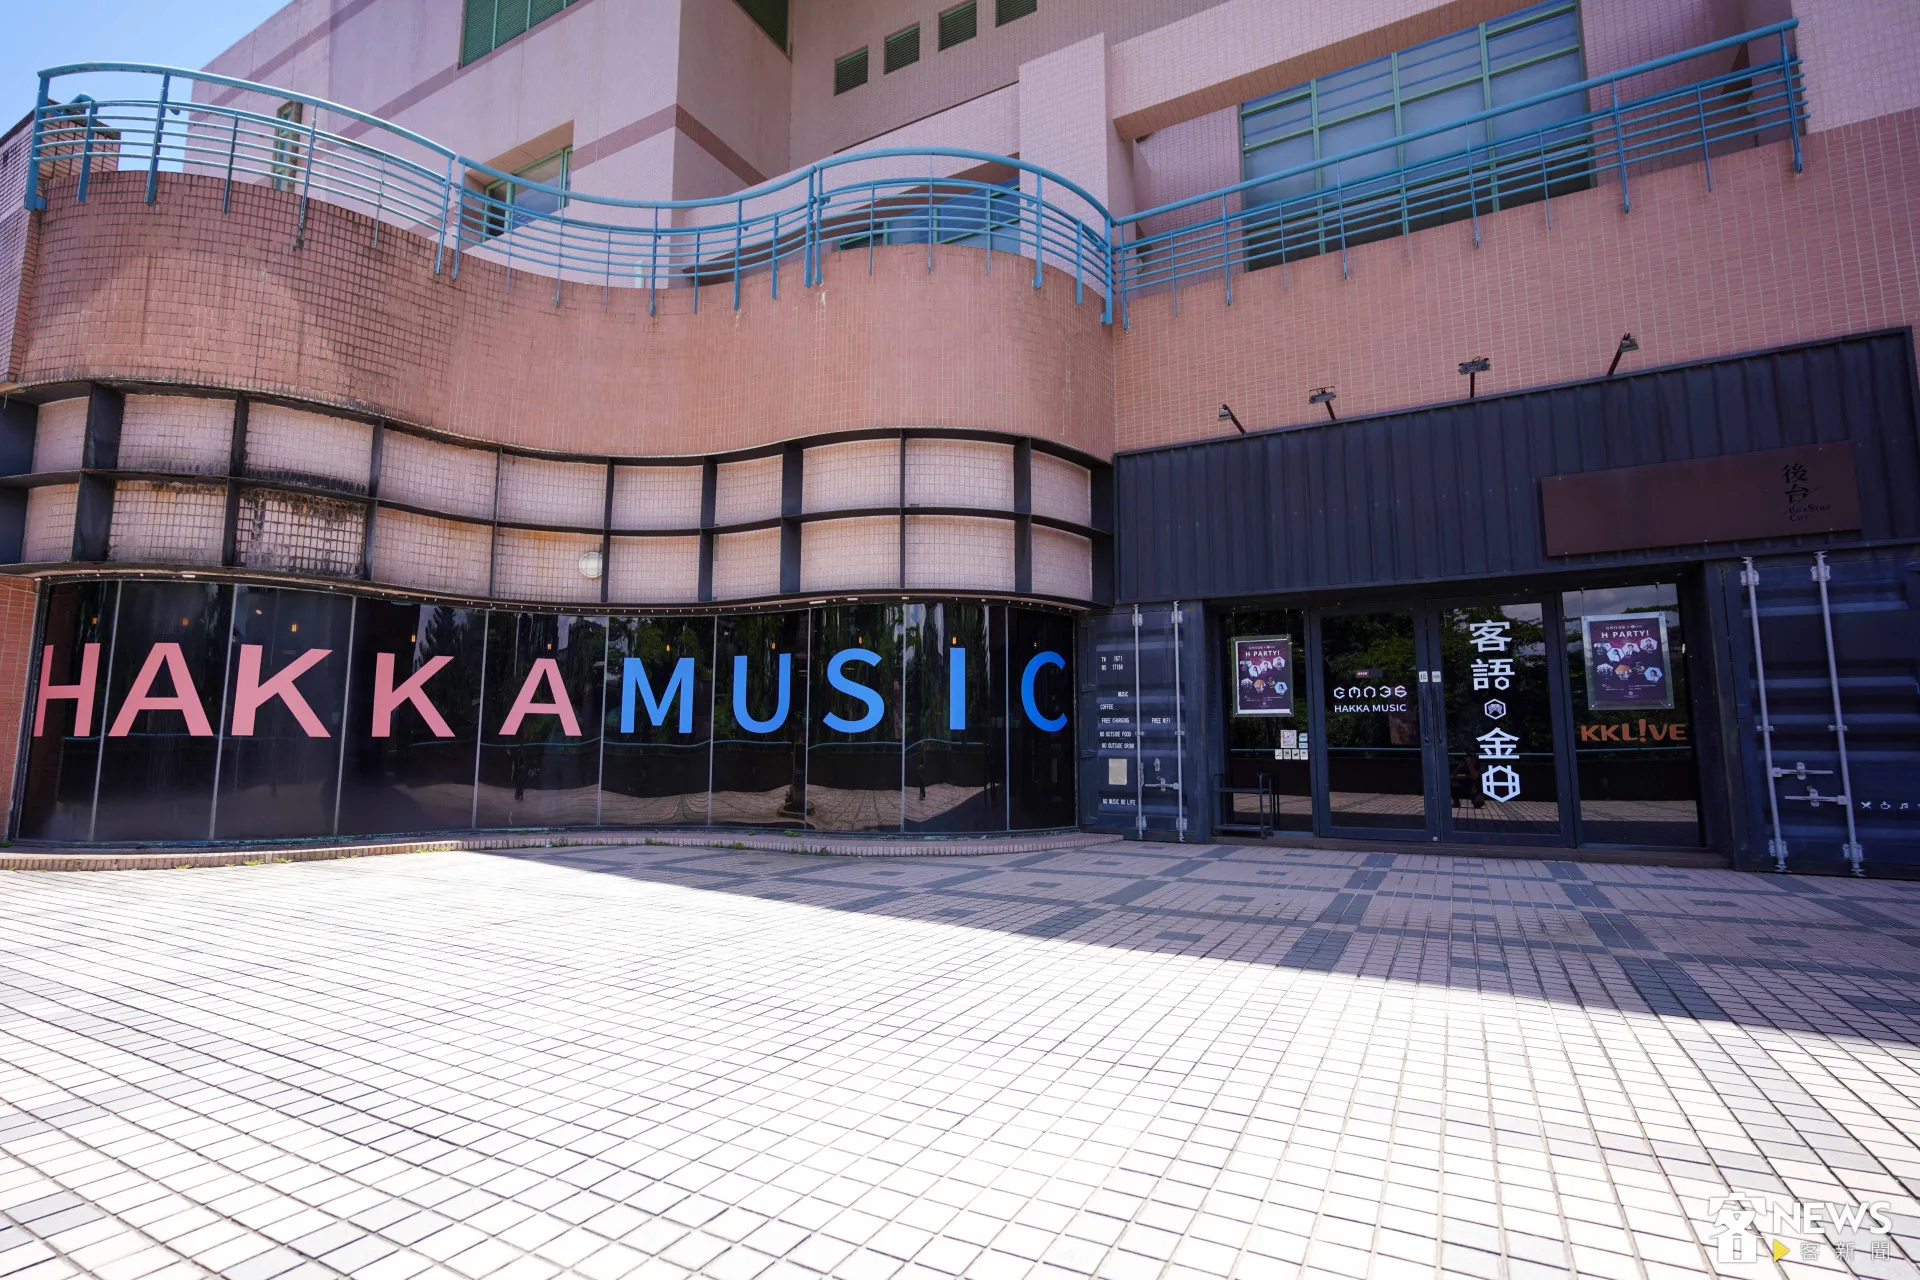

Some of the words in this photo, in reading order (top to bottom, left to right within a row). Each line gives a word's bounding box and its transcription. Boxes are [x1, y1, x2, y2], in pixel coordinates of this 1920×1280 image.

[1782, 463, 1809, 503] 後台
[1612, 629, 1650, 639] PARTY!
[1253, 649, 1280, 657] PARTY!
[1469, 619, 1516, 691] 客語
[33, 642, 583, 738] HAKKA
[620, 647, 1068, 734] MUSIC
[1334, 704, 1370, 713] HAKKA
[1372, 703, 1407, 712] MUSIC
